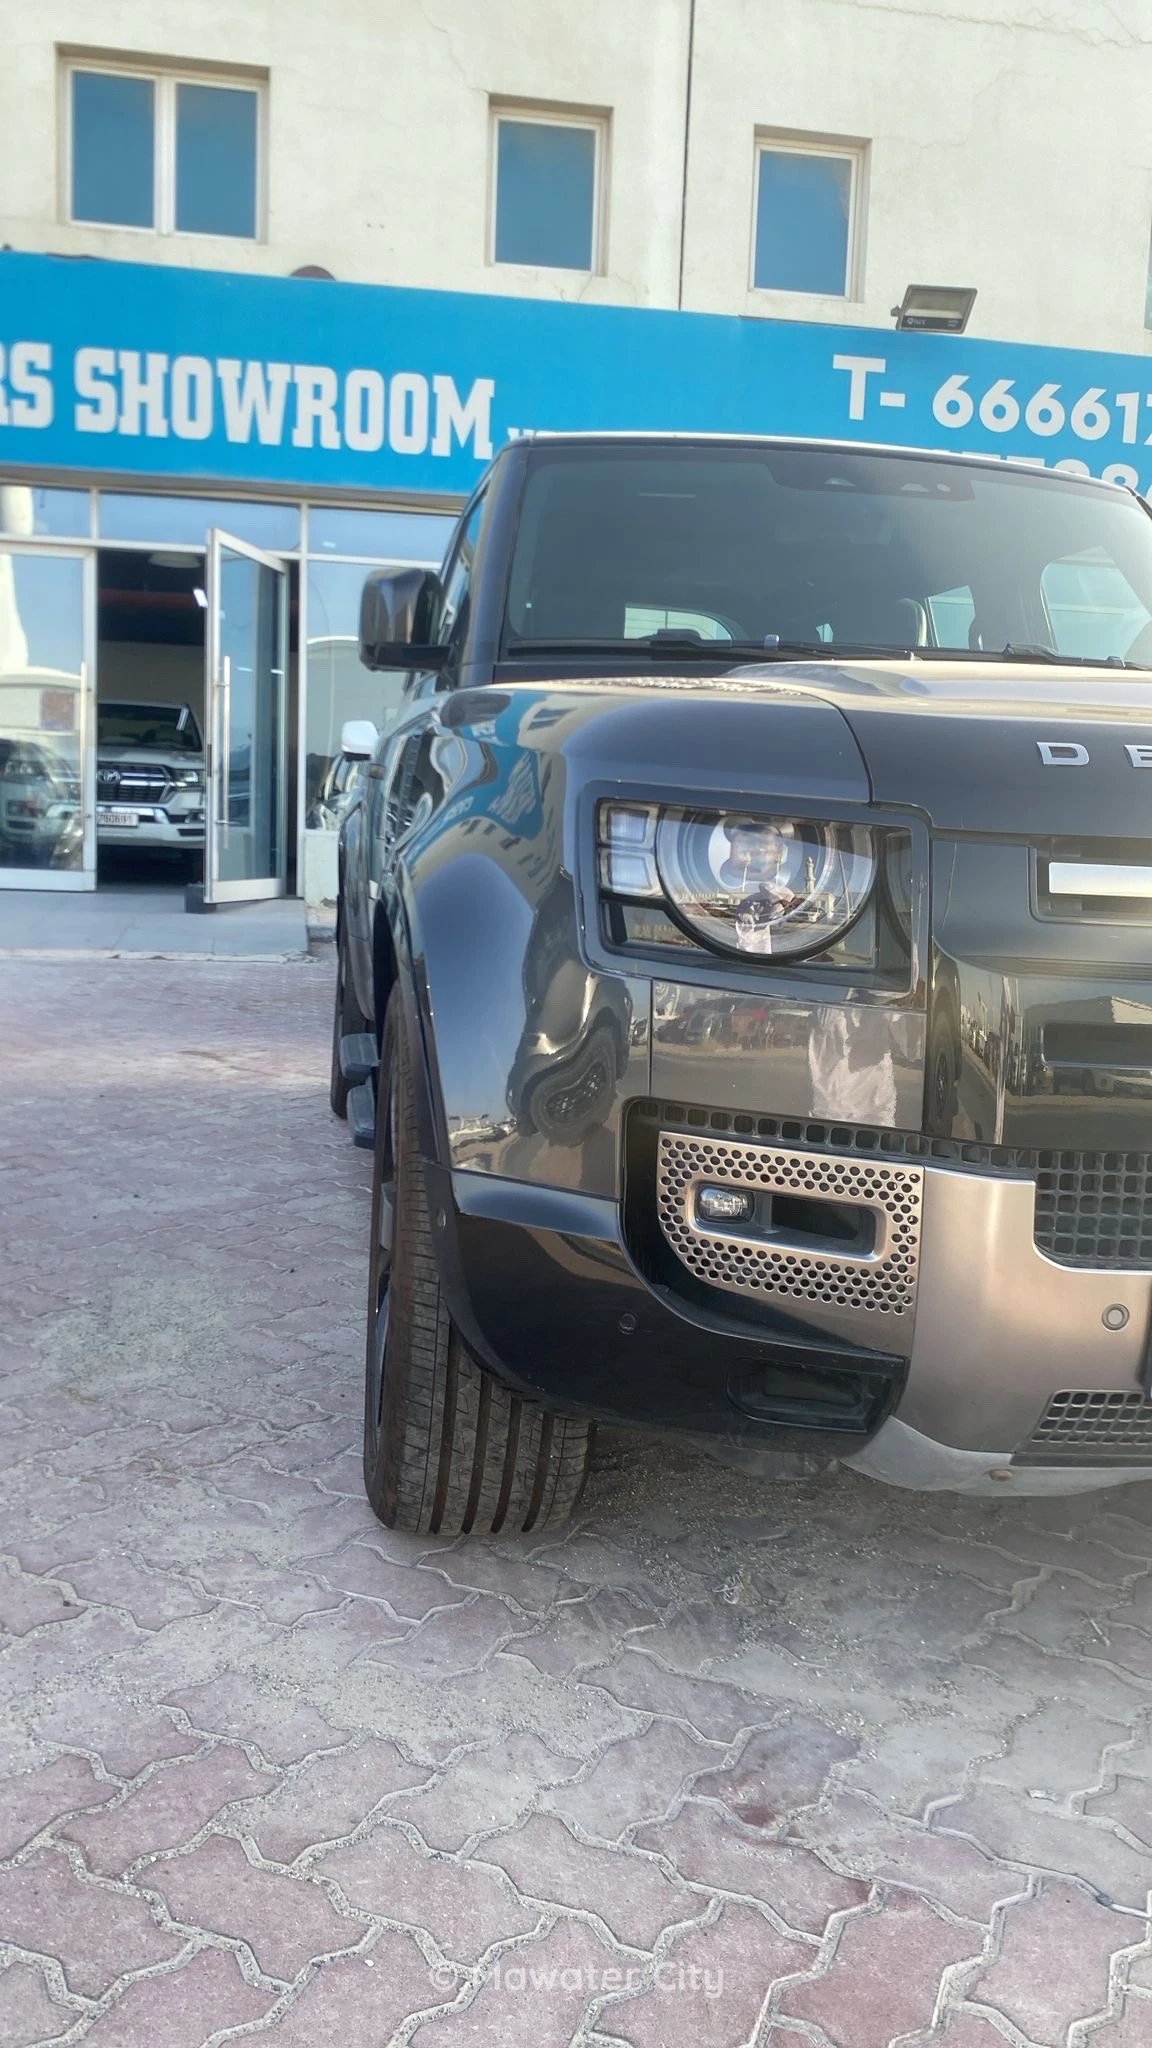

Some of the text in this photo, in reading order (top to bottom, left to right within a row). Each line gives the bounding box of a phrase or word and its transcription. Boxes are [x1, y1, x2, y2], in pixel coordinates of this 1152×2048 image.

[0, 340, 496, 460] S SHOWROOM
[832, 354, 1152, 446] T- 66661
